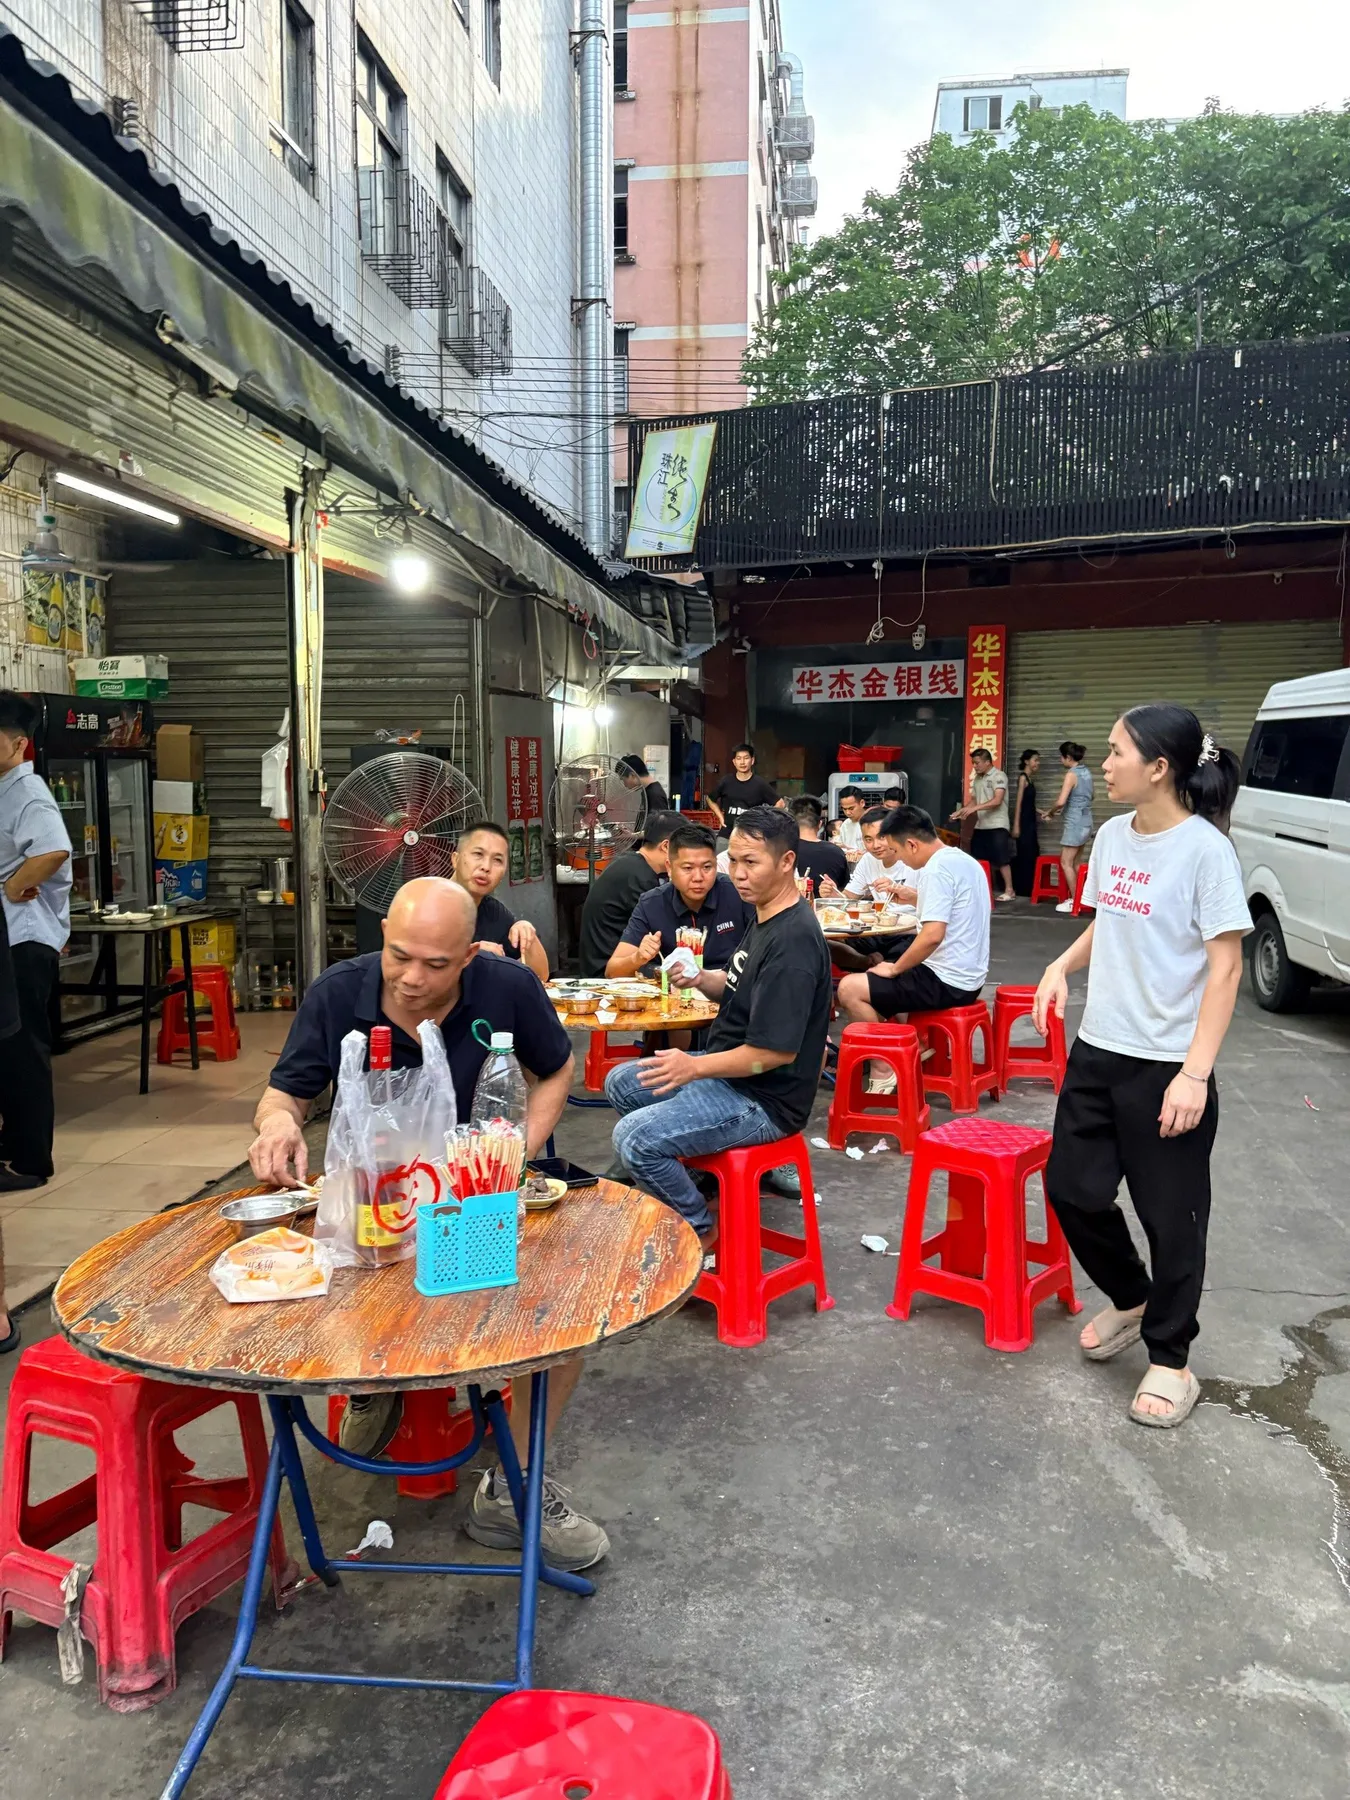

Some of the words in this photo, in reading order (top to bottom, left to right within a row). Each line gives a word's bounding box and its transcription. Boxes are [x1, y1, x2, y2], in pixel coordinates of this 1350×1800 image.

[657, 453, 673, 486] 珠江
[796, 663, 959, 701] 华杰金银线
[76, 713, 99, 730] 志高
[510, 740, 522, 818] 健康过节
[527, 740, 539, 816] 健康过节
[1110, 864, 1126, 878] WE
[1128, 870, 1151, 885] ARE
[1113, 881, 1133, 896] ALL
[716, 920, 735, 932] CHINA
